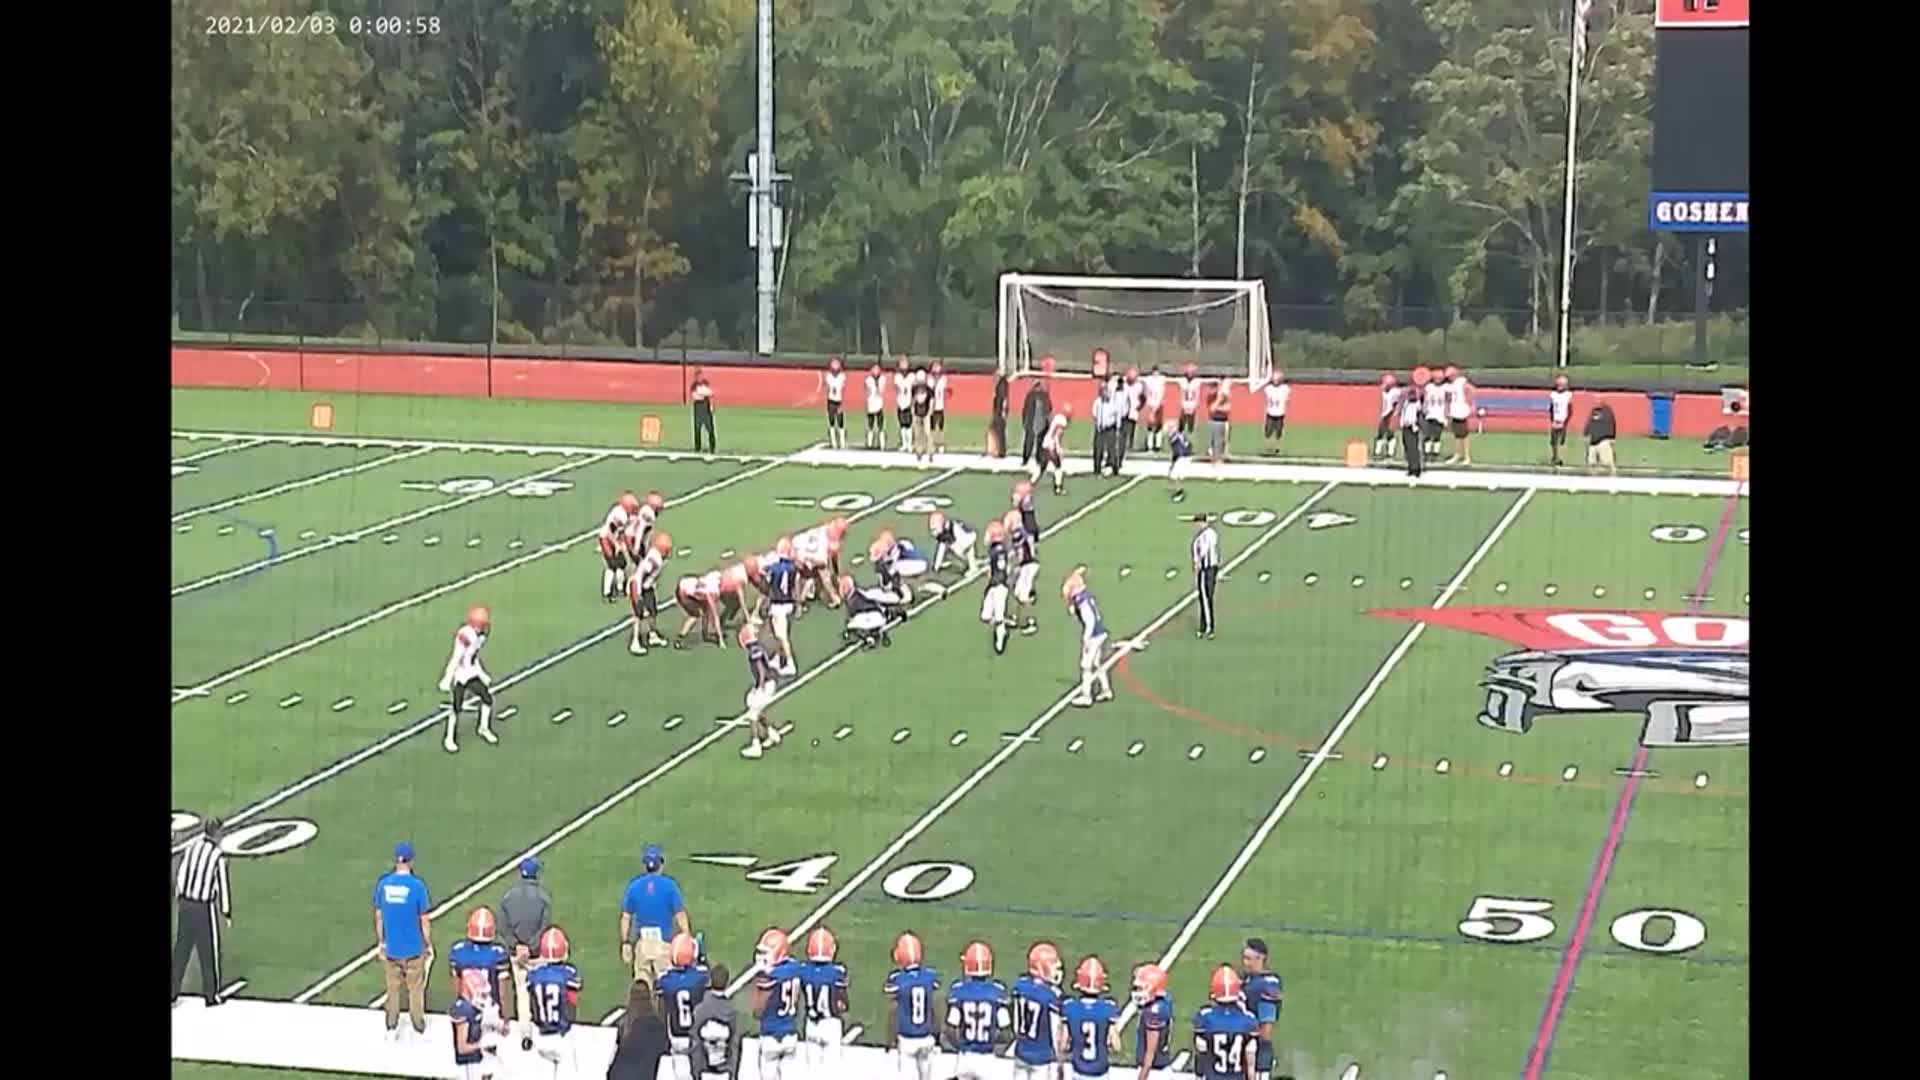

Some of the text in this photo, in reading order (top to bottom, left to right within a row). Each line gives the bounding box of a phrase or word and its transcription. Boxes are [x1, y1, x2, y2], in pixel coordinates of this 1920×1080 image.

[1656, 201, 1749, 223] GOSHEN
[536, 984, 560, 1024] 12
[676, 990, 692, 1027] 6
[911, 986, 926, 1025] 8
[962, 1001, 992, 1042] 52
[1081, 1021, 1097, 1060] 3
[1213, 1033, 1244, 1075] 54
